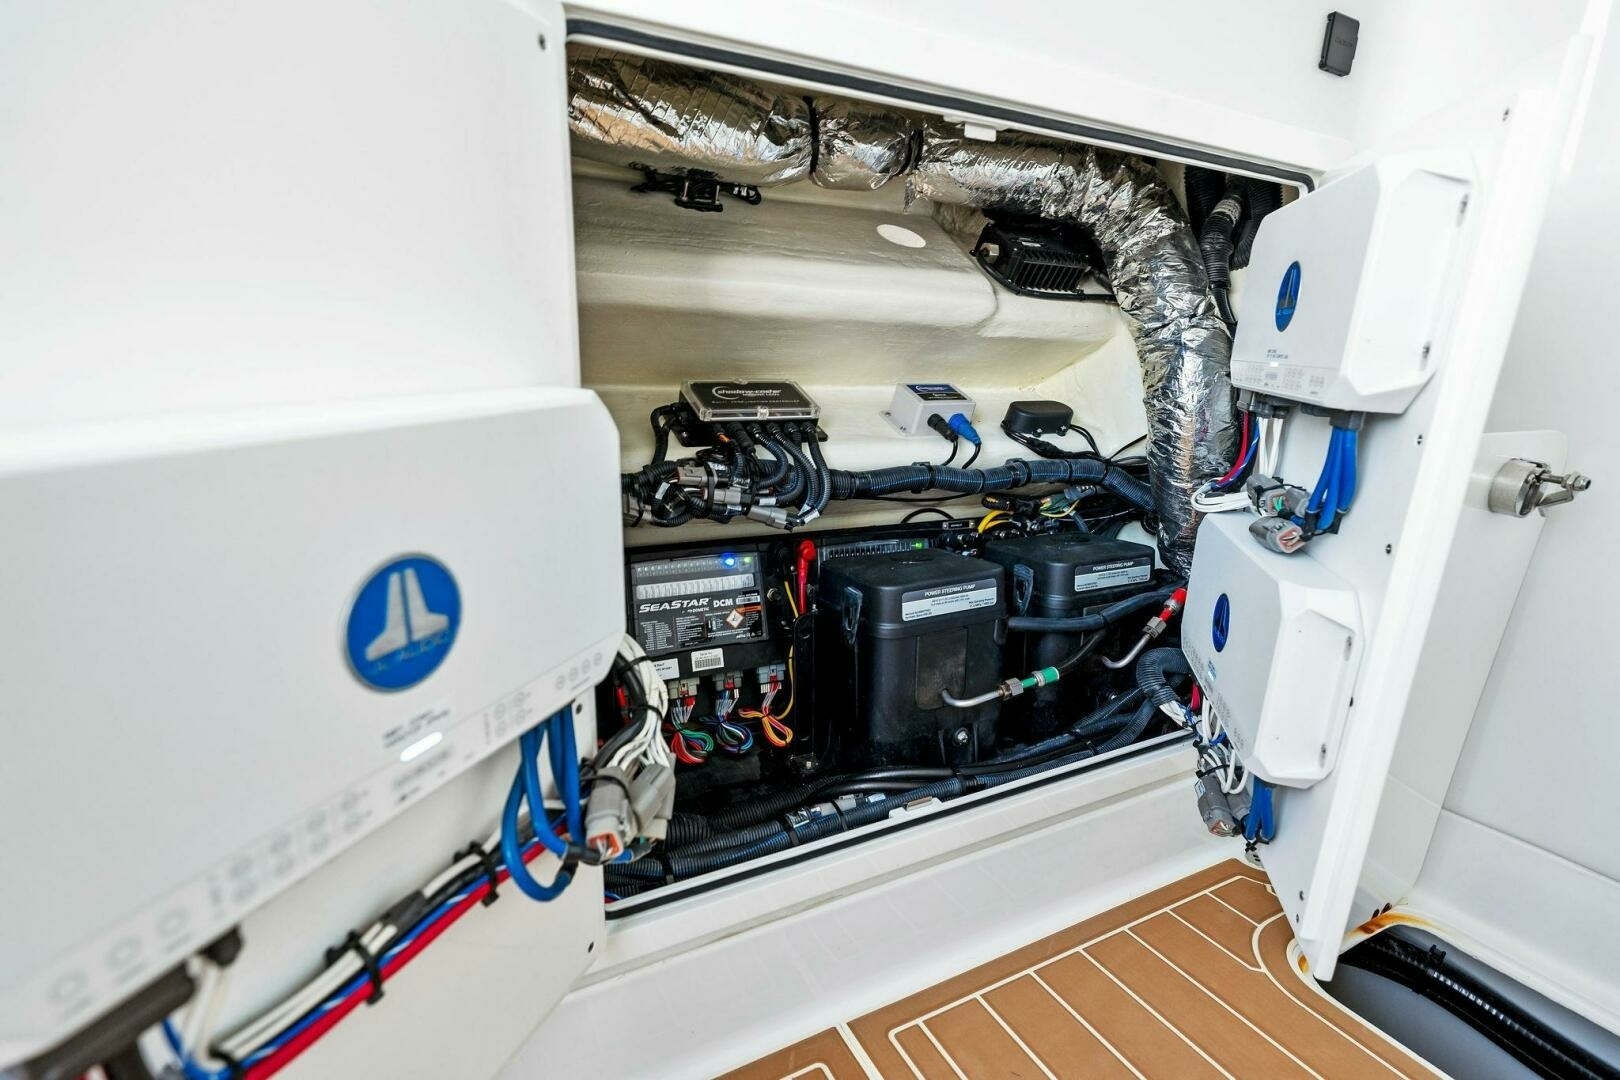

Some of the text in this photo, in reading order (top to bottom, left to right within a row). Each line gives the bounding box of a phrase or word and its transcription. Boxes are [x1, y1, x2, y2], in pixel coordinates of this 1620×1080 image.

[924, 583, 976, 597] POWER STEERING PUMP
[713, 598, 734, 608] DCM
